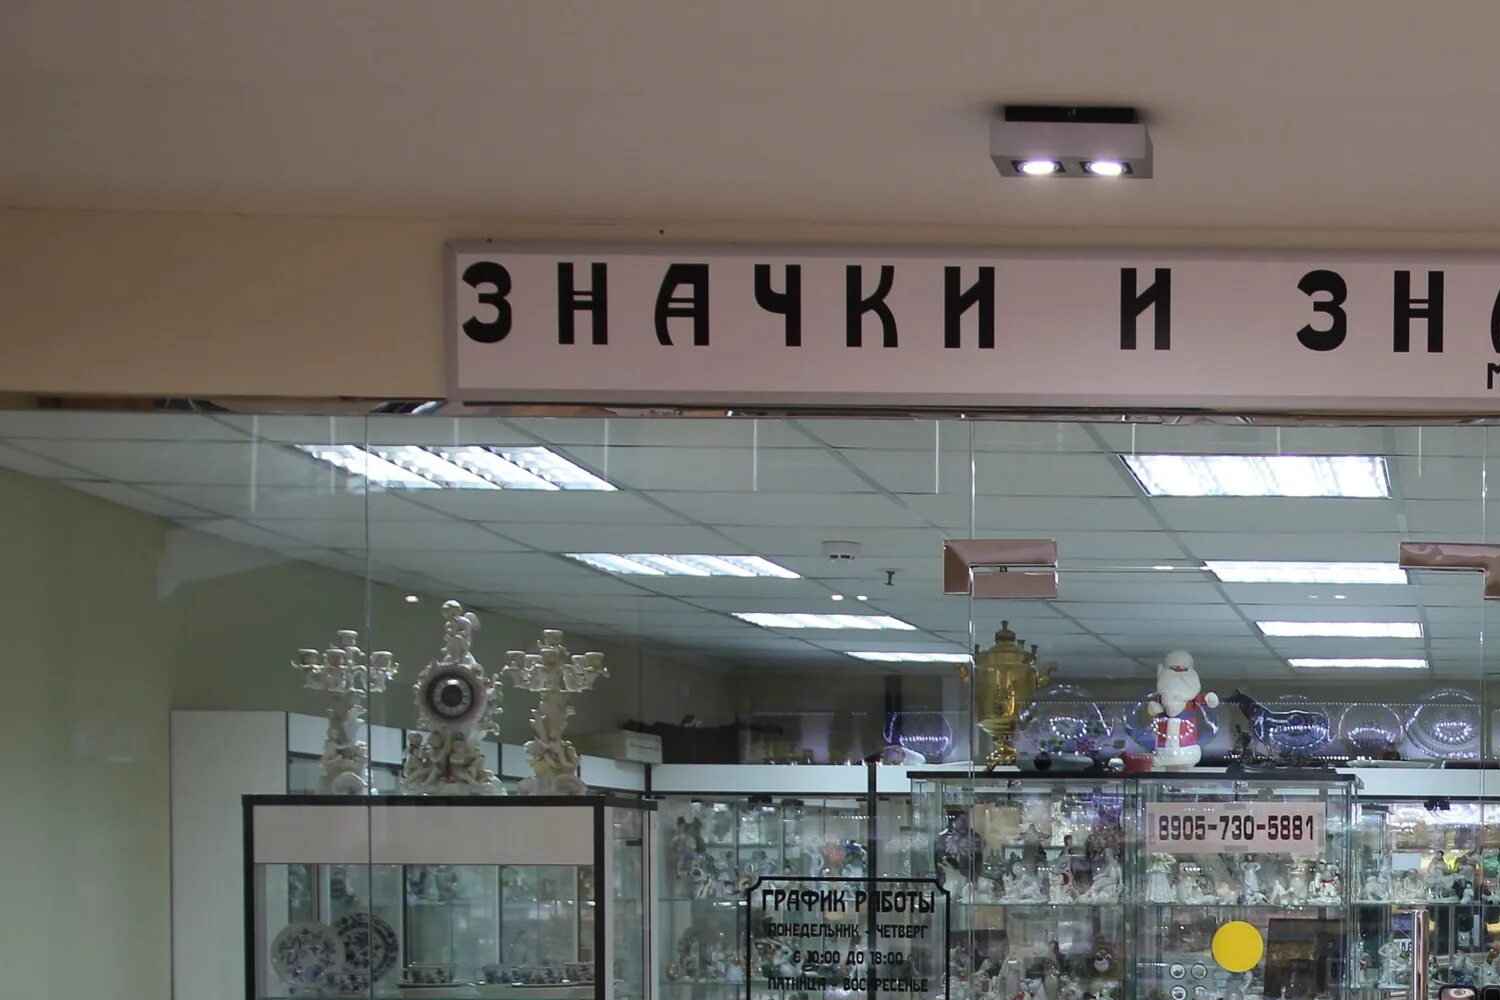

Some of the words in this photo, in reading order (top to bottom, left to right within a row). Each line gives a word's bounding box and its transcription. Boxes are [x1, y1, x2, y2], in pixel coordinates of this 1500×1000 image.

[461, 260, 996, 350] ЗНАЧКИ
[1119, 267, 1172, 351] И
[1158, 814, 1315, 841] 8905-730-5881
[761, 888, 846, 913] ГРАФИК
[767, 922, 860, 939] ПОНЕДЕЛЬНИК
[876, 924, 928, 939] ЧЕТВЕРГ
[806, 950, 841, 965] 10:00
[846, 950, 865, 966] ДО
[870, 951, 904, 965] 18:00
[767, 975, 827, 991] ПЯТНИЦА
